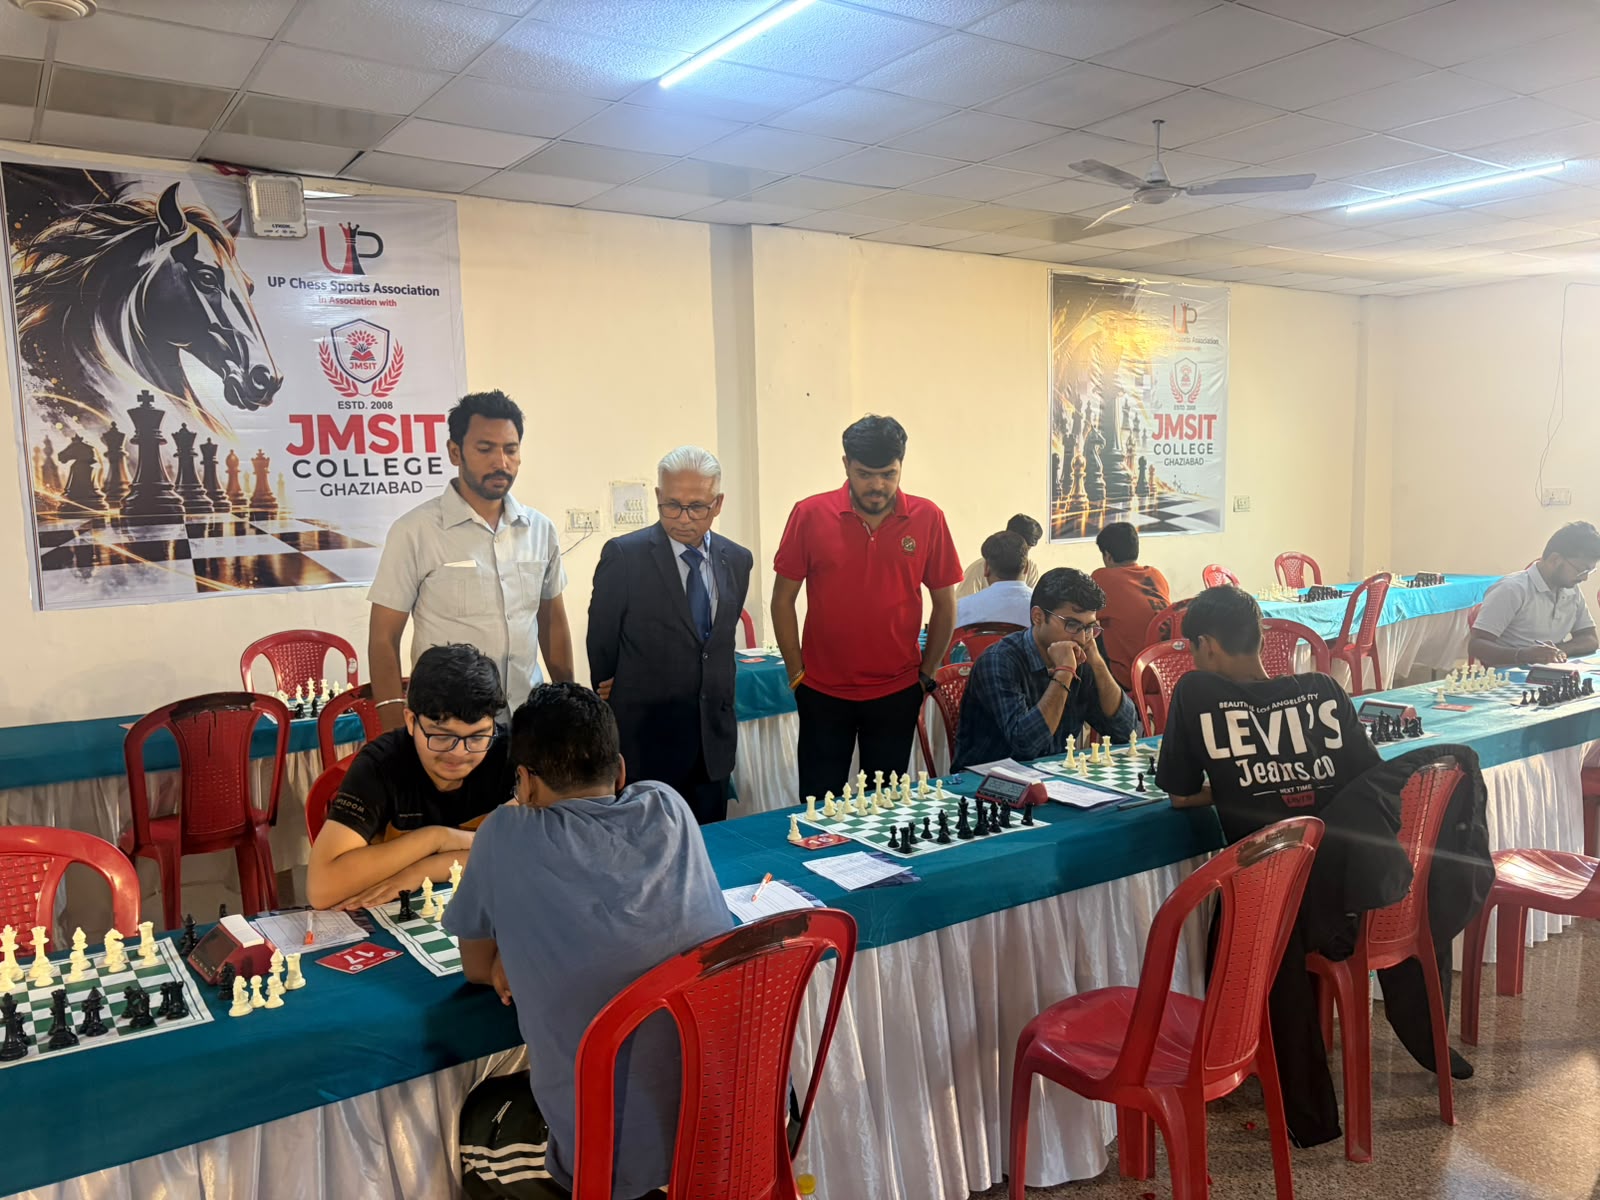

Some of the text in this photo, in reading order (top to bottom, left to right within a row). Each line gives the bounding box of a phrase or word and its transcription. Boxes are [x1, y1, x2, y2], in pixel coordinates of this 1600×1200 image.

[267, 276, 440, 297] UP Chess Sports Association
[318, 295, 397, 307] In Association with
[349, 362, 378, 370] JMSIT
[337, 400, 394, 410] ESTD. 2008
[286, 413, 446, 456] JMSIT
[1151, 413, 1218, 440] JMSIT
[1153, 442, 1214, 456] COLLEGE
[292, 457, 443, 478] COLLEGE
[1163, 457, 1205, 467] GHAZIABAD
[319, 480, 423, 497] GHAZIABAD
[1271, 694, 1306, 710] ANGELES
[1306, 692, 1319, 701] ITY
[1200, 699, 1344, 760] LEVI'S
[1279, 783, 1313, 794] NEXT TIME
